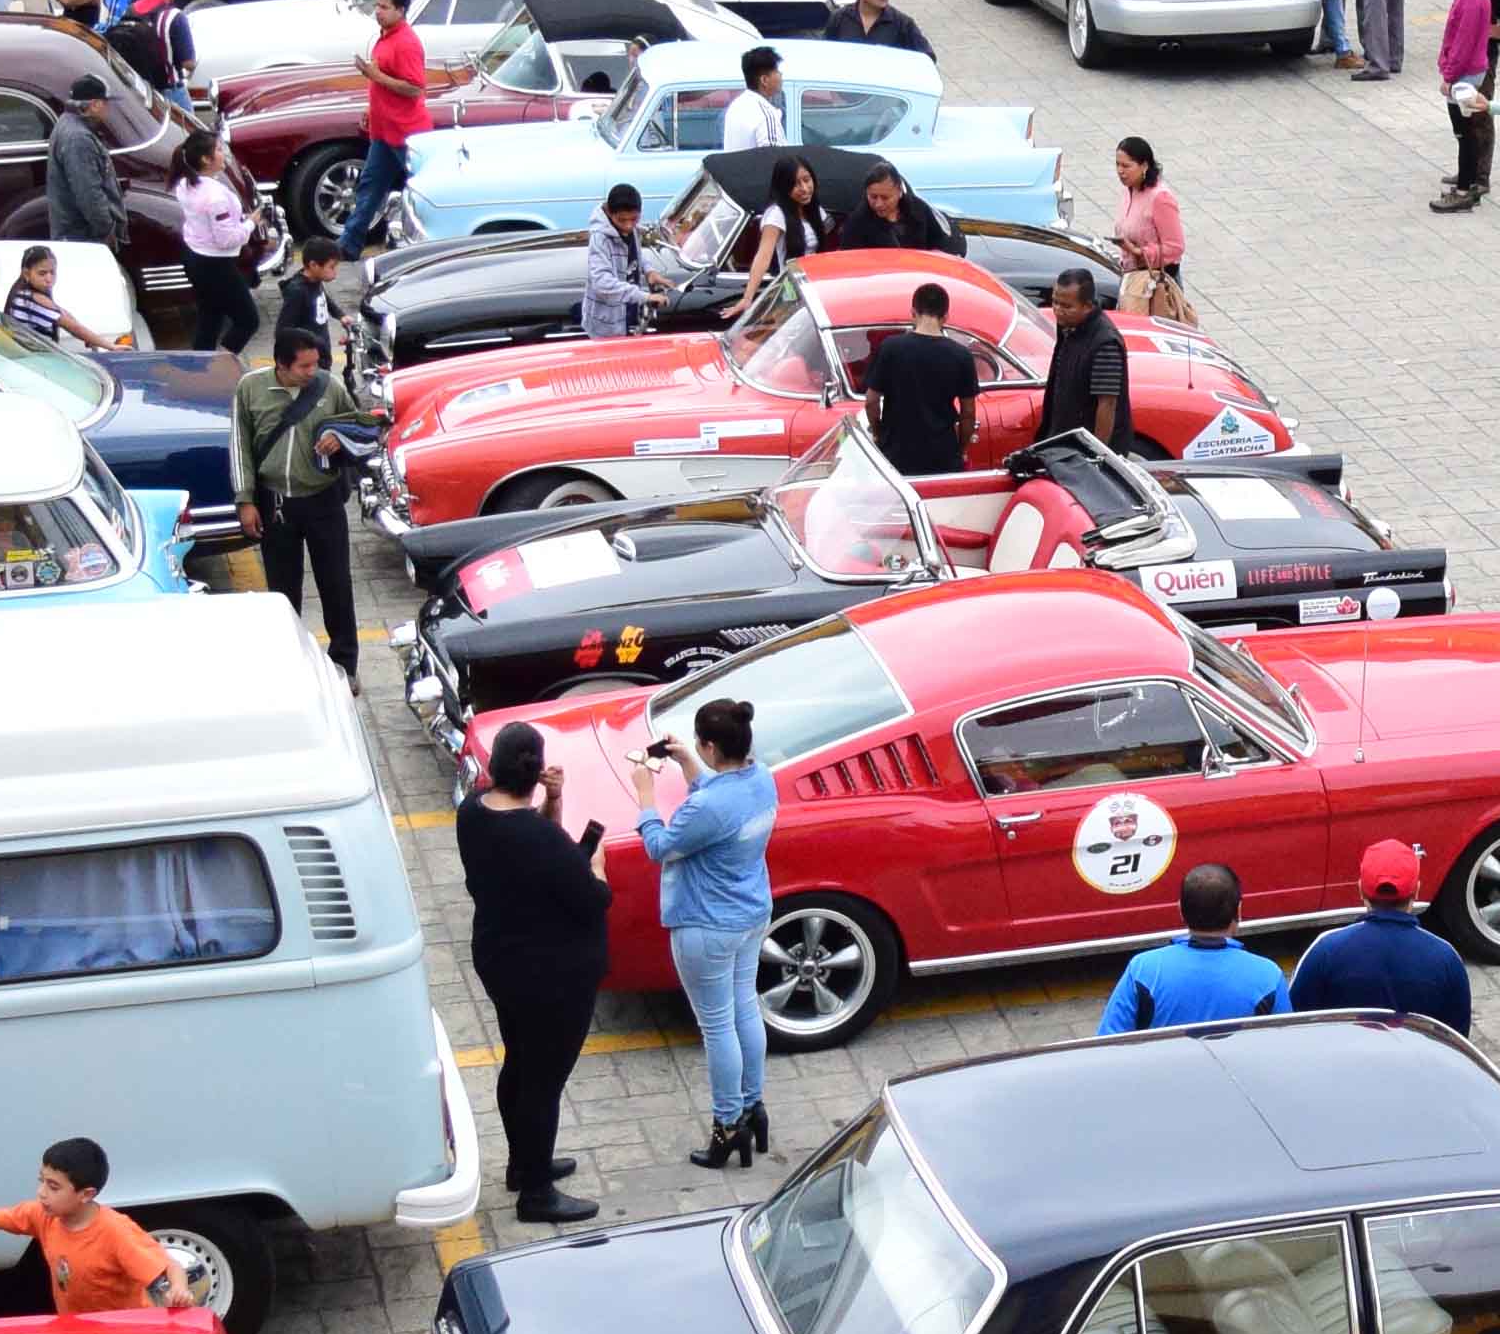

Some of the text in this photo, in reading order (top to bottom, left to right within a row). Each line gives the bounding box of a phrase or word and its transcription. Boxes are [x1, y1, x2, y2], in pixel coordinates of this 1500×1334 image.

[1196, 435, 1253, 449] ESCUDERIA
[1210, 443, 1265, 457] CATRACHA
[1154, 568, 1226, 595] Quién
[1247, 568, 1278, 586] LIFE
[1294, 564, 1333, 581] STYLE
[1362, 570, 1426, 585] Thunderbird
[1109, 852, 1142, 876] 21
